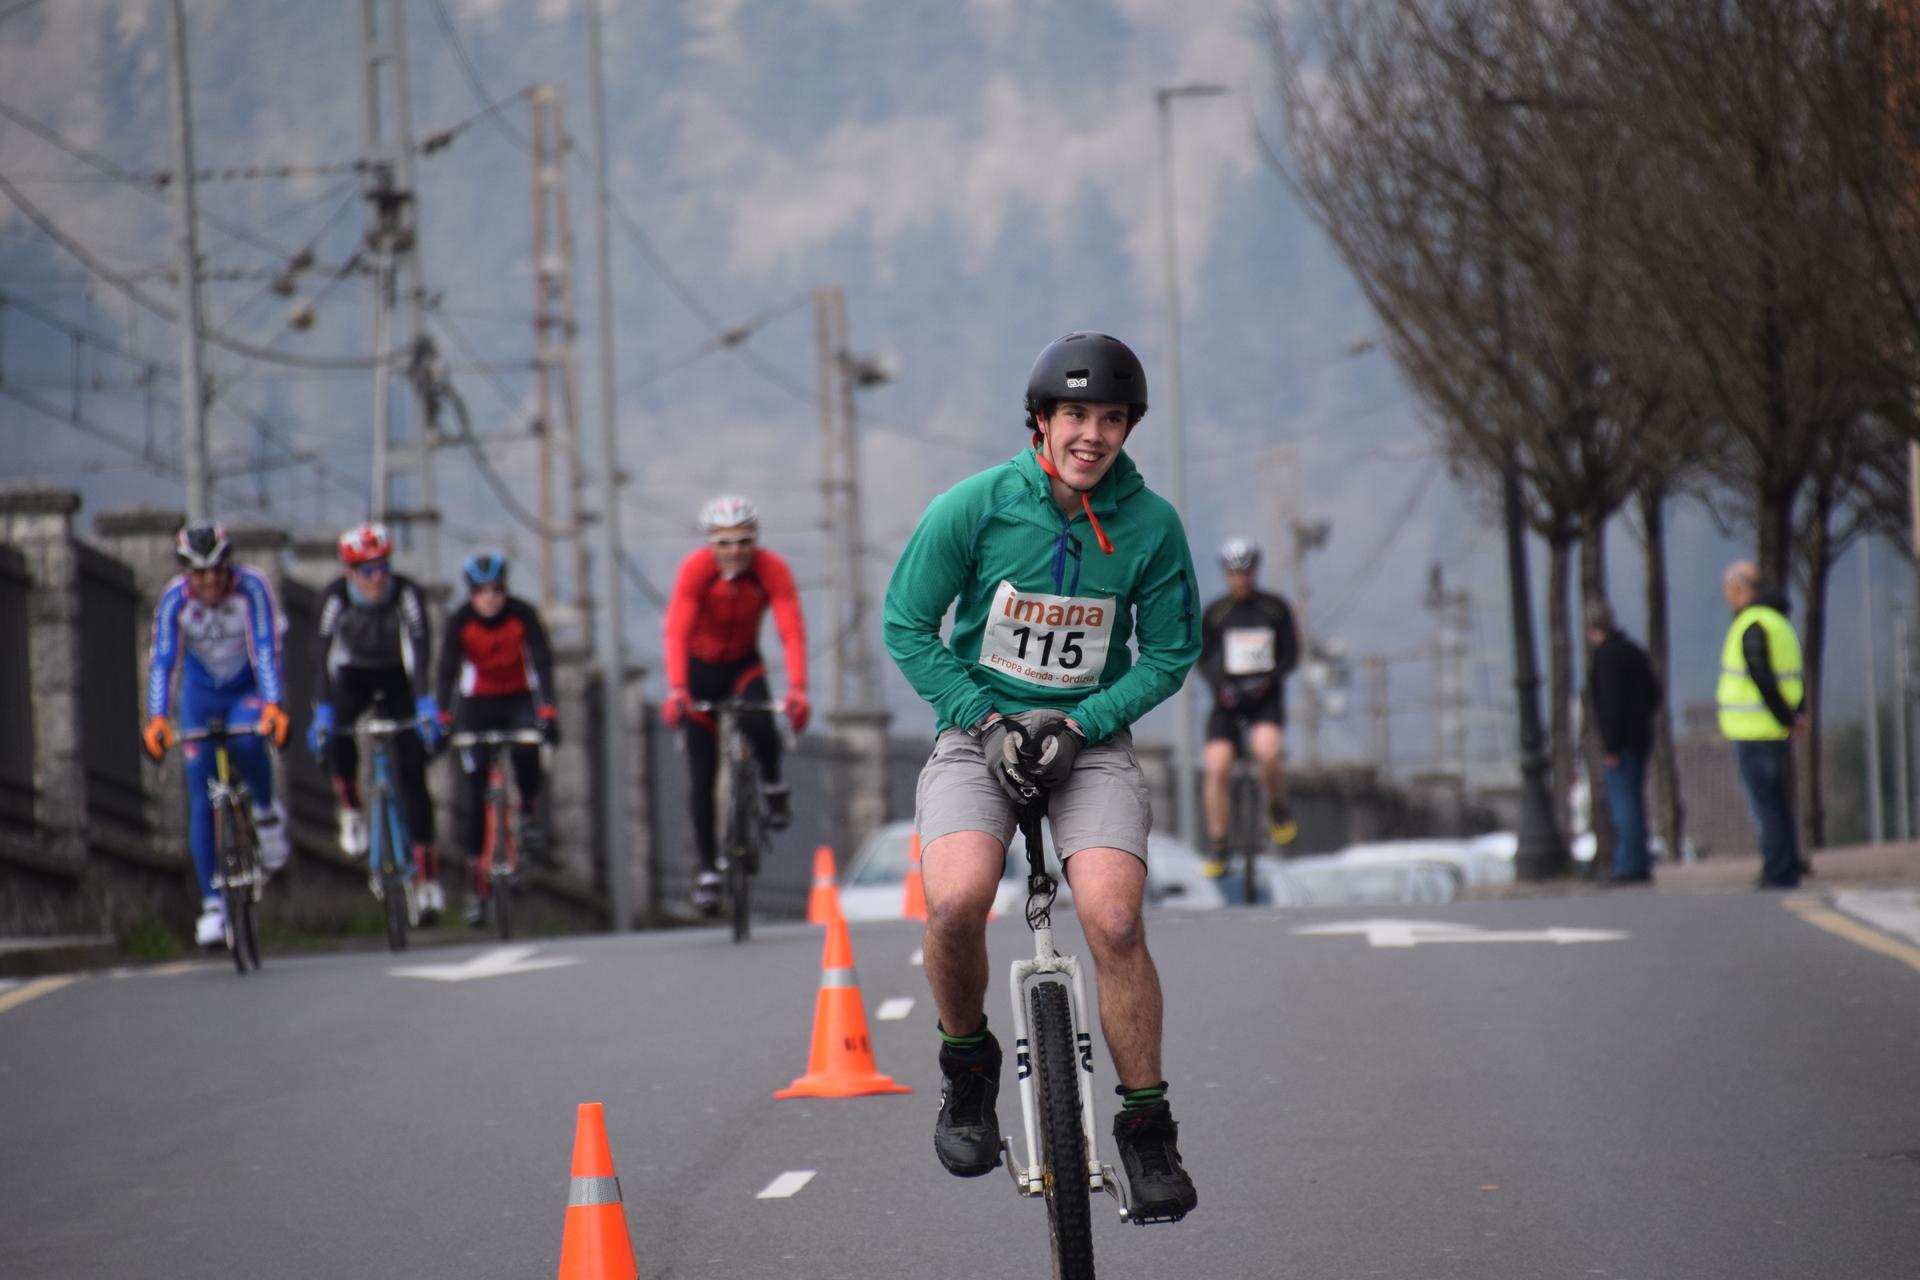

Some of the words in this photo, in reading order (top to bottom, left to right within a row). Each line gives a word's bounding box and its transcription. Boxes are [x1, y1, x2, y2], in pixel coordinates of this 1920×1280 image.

[1003, 591, 1104, 627] imana
[1013, 626, 1085, 669] 115
[991, 654, 1023, 673] Erropa
[1024, 667, 1053, 681] denda
